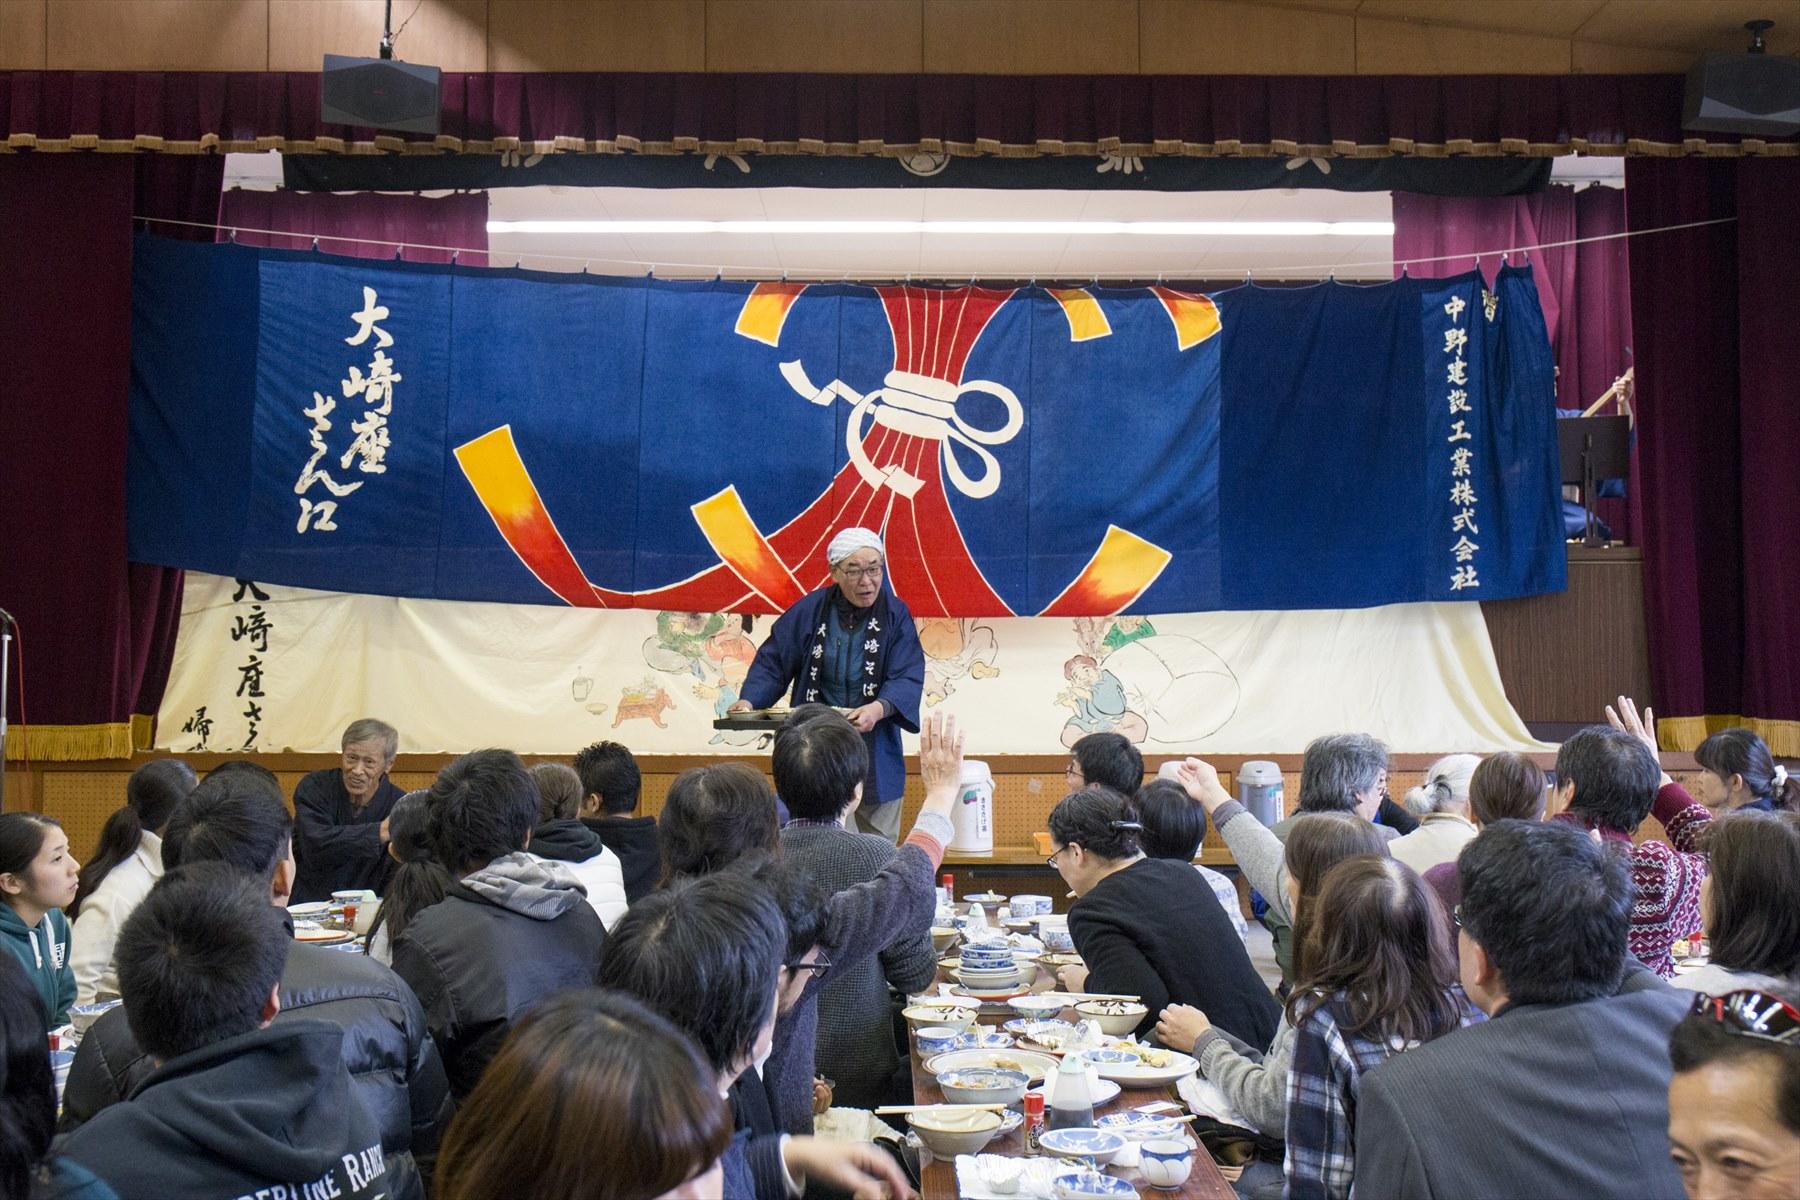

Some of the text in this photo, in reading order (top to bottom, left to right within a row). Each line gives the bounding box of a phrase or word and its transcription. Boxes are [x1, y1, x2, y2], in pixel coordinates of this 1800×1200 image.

[1443, 295, 1480, 591] 中野建設工業株式会社
[805, 623, 827, 702] 大崎そば
[862, 617, 881, 697] 大崎そば
